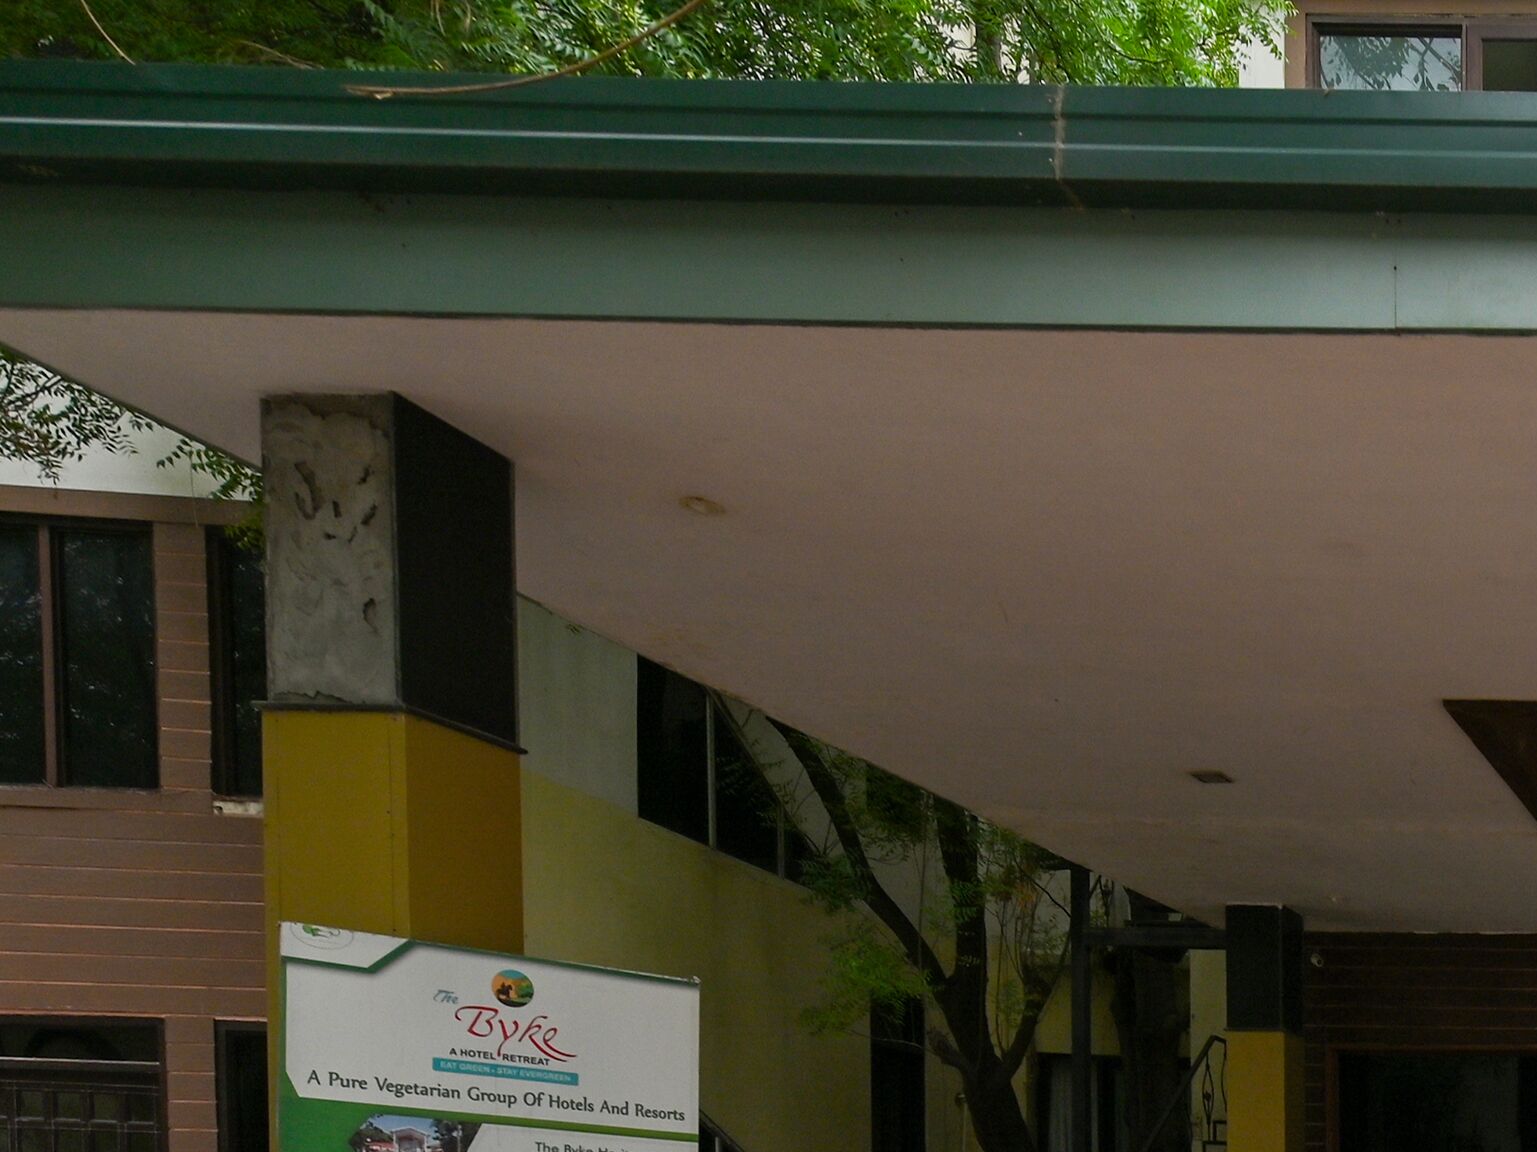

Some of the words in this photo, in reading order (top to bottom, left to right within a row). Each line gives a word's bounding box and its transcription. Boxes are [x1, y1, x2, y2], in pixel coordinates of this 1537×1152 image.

[433, 989, 459, 1005] The
[455, 1005, 577, 1062] Byke
[449, 1048, 458, 1056] A
[460, 1048, 496, 1060] HOTEL
[503, 1053, 550, 1066] RETREAT
[440, 1061, 457, 1069] EAT
[459, 1063, 490, 1073] GREEN
[497, 1068, 517, 1076] STAY
[520, 1070, 571, 1081] EVERGREEN
[307, 1070, 320, 1085] A
[329, 1072, 367, 1090] Pure
[374, 1076, 461, 1099] Vegetarian
[467, 1086, 517, 1108] Group
[524, 1092, 544, 1107] Of
[549, 1094, 594, 1113] Hotels
[600, 1100, 629, 1117] And
[635, 1103, 685, 1122] Resorts
